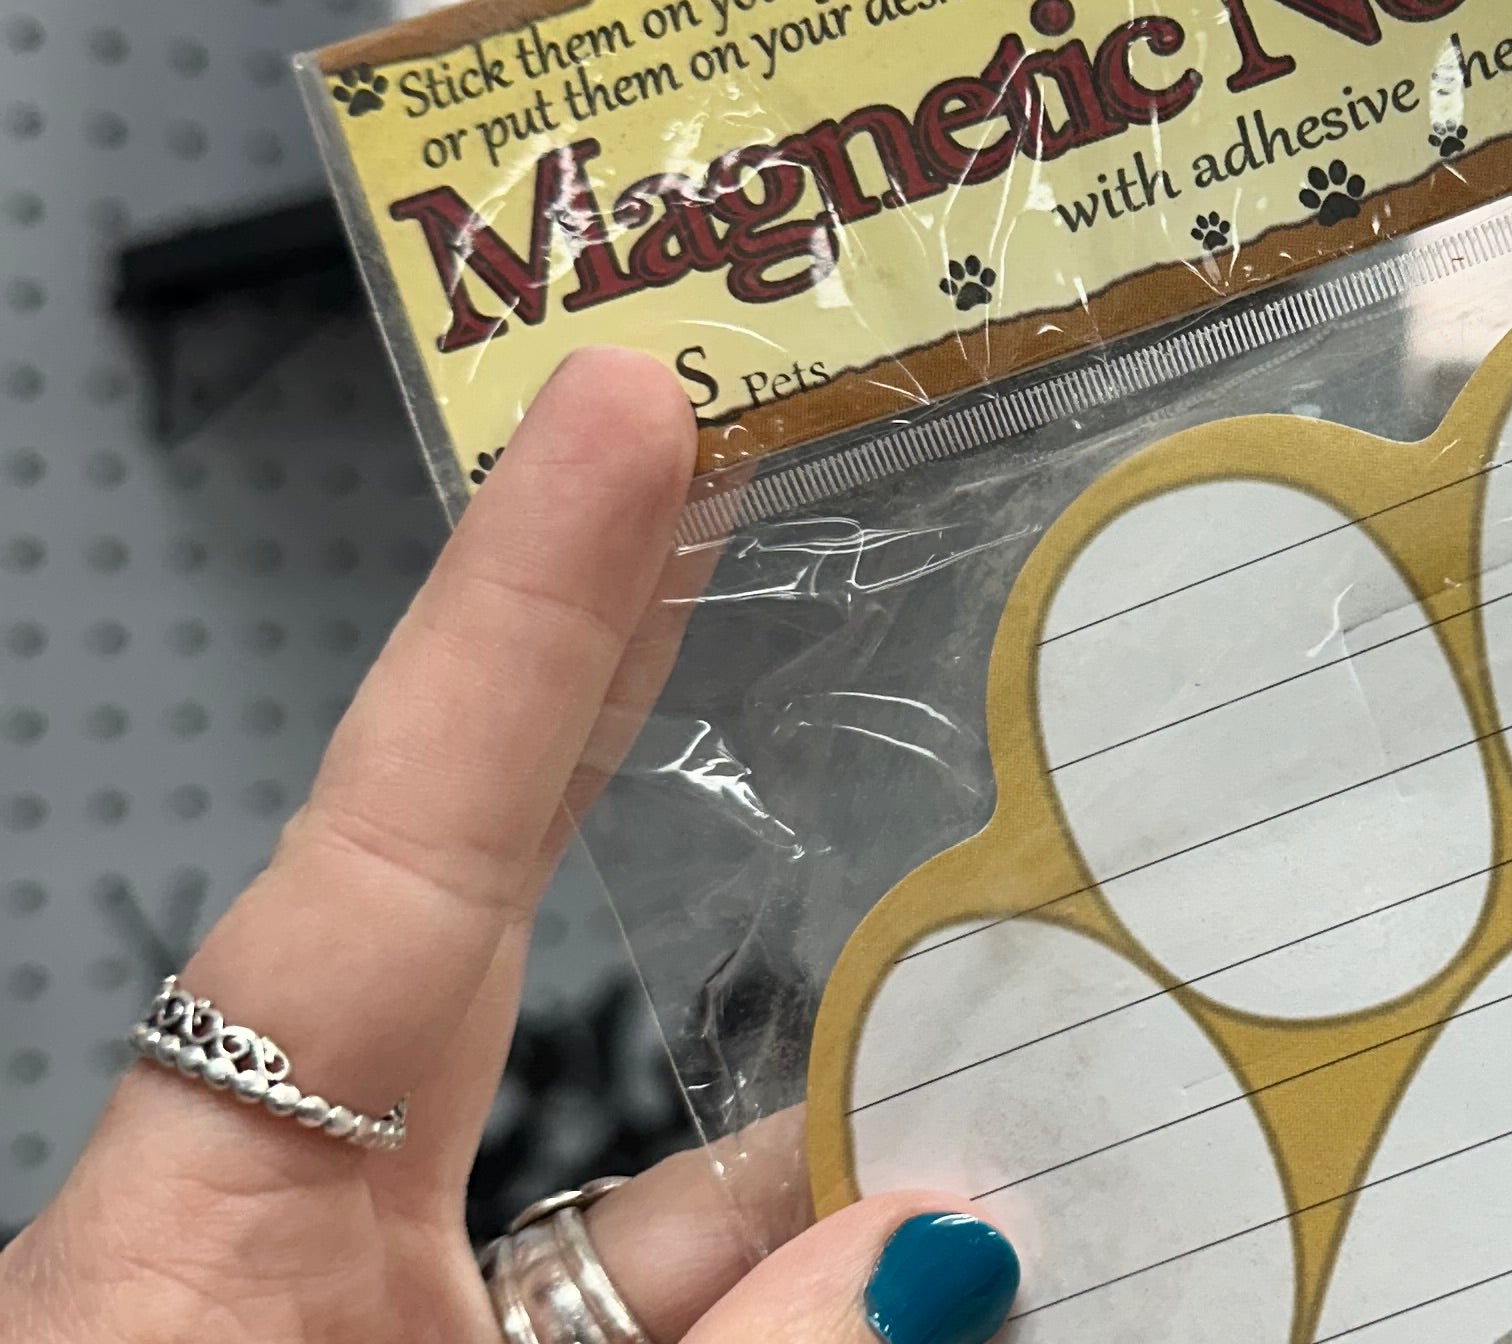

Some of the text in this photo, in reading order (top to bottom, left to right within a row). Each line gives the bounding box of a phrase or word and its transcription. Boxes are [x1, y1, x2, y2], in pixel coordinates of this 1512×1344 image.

[398, 43, 508, 120] Stick
[513, 16, 634, 83] them
[642, 0, 699, 40] on
[421, 125, 467, 169] or
[476, 93, 557, 167] put
[562, 58, 680, 124] them
[689, 38, 744, 82] on
[750, 1, 853, 80] your
[1050, 150, 1183, 234] with
[1190, 76, 1422, 190] adhesive
[739, 360, 833, 409] Pets
